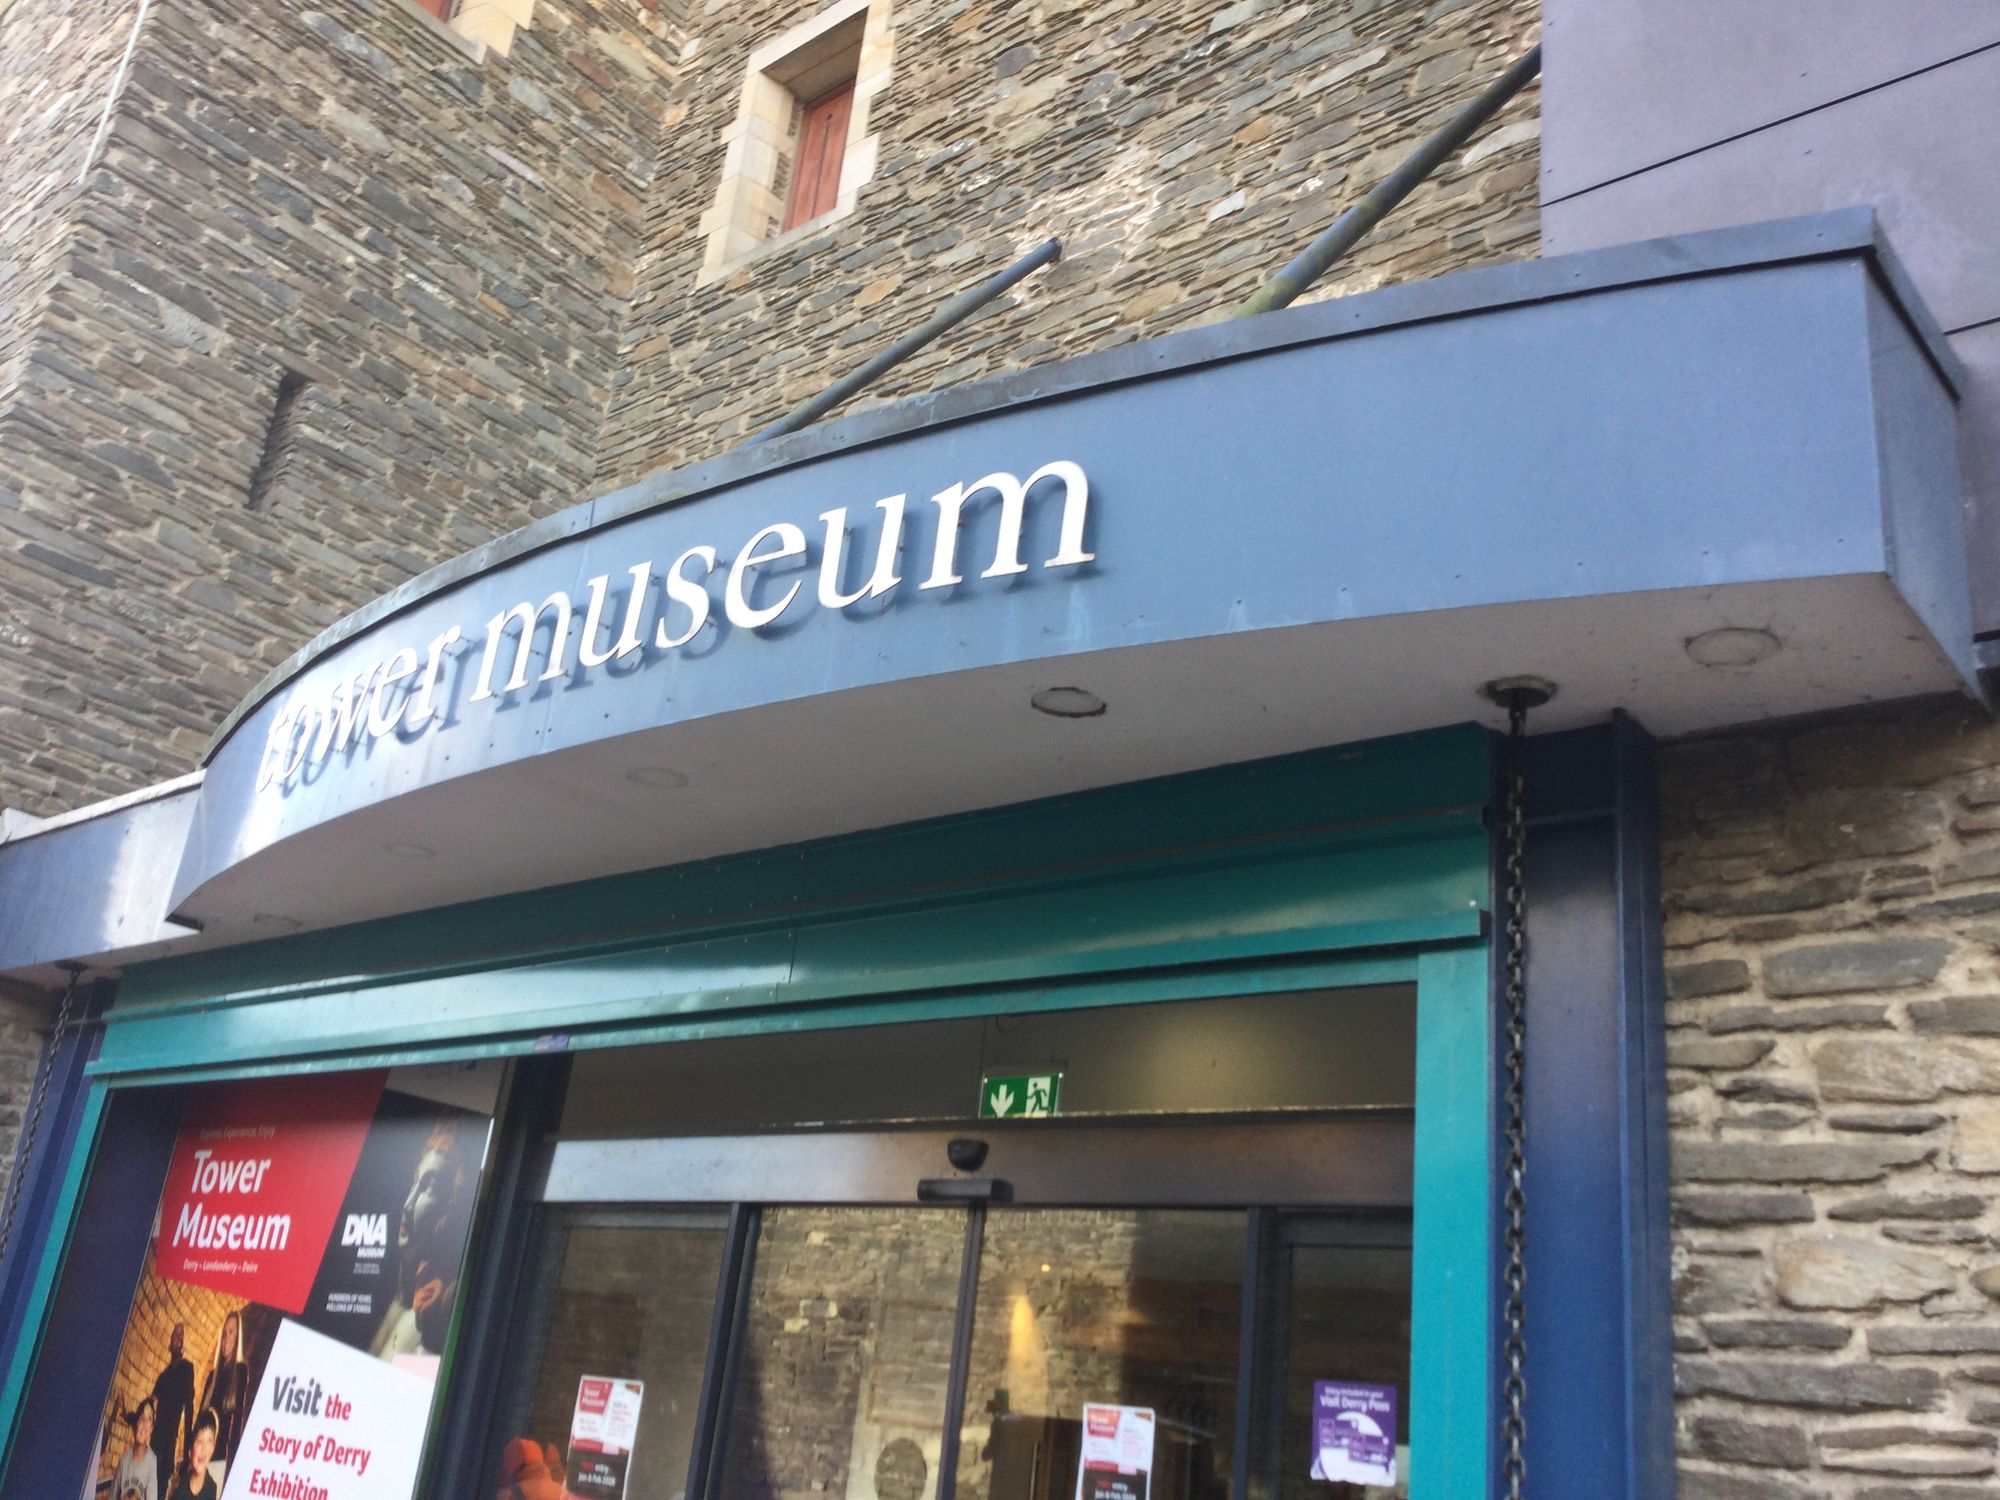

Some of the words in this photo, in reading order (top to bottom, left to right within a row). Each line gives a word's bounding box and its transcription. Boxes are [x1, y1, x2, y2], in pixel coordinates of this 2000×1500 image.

[255, 624, 462, 793] tower
[468, 460, 1097, 702] museum
[191, 1149, 272, 1195] Tower
[172, 1202, 292, 1251] Museum
[341, 1213, 388, 1247] DNA
[356, 1247, 386, 1259] MUSEUM
[272, 1376, 323, 1417] Visit
[324, 1393, 352, 1421] the
[258, 1427, 302, 1465] Story
[303, 1434, 324, 1461] of
[322, 1437, 372, 1477] Derry
[249, 1468, 329, 1500] Exhibition
